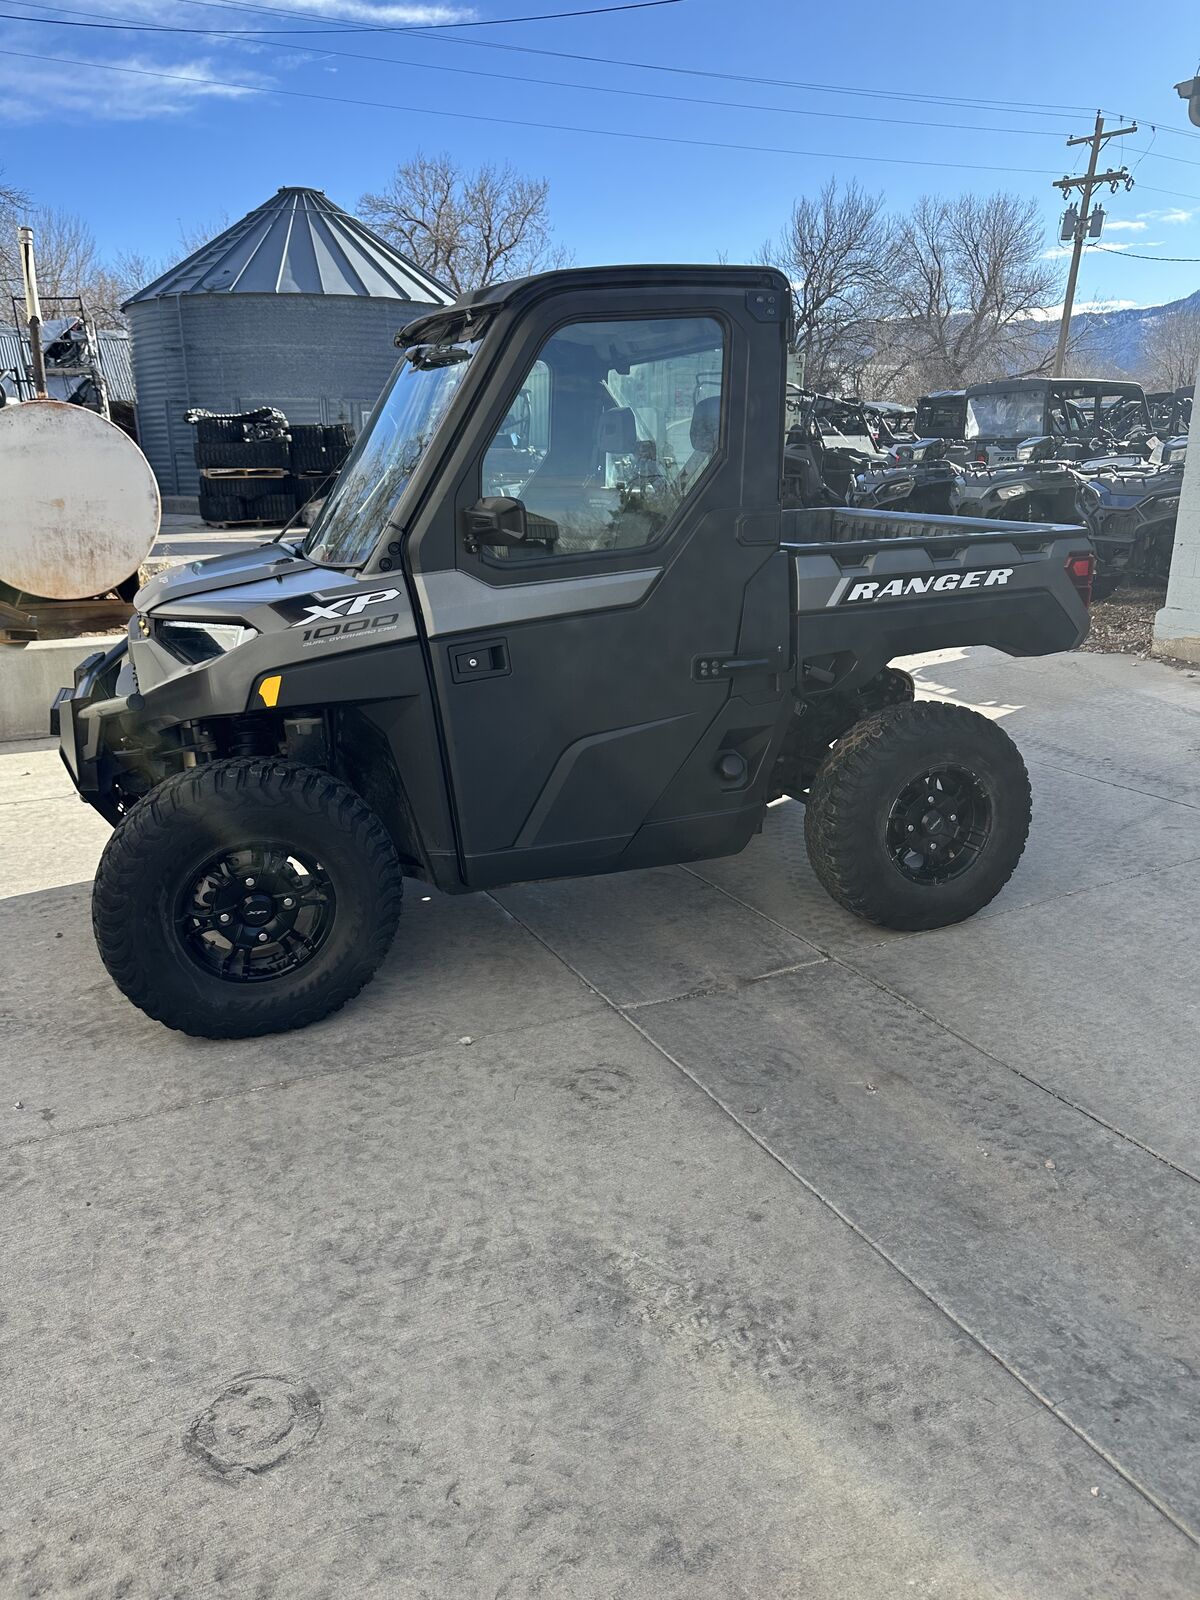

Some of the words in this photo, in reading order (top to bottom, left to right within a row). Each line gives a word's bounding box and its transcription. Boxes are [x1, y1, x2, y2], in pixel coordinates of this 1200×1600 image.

[847, 568, 1014, 601] RANGER
[288, 587, 402, 629] XP
[303, 613, 400, 641] 1000
